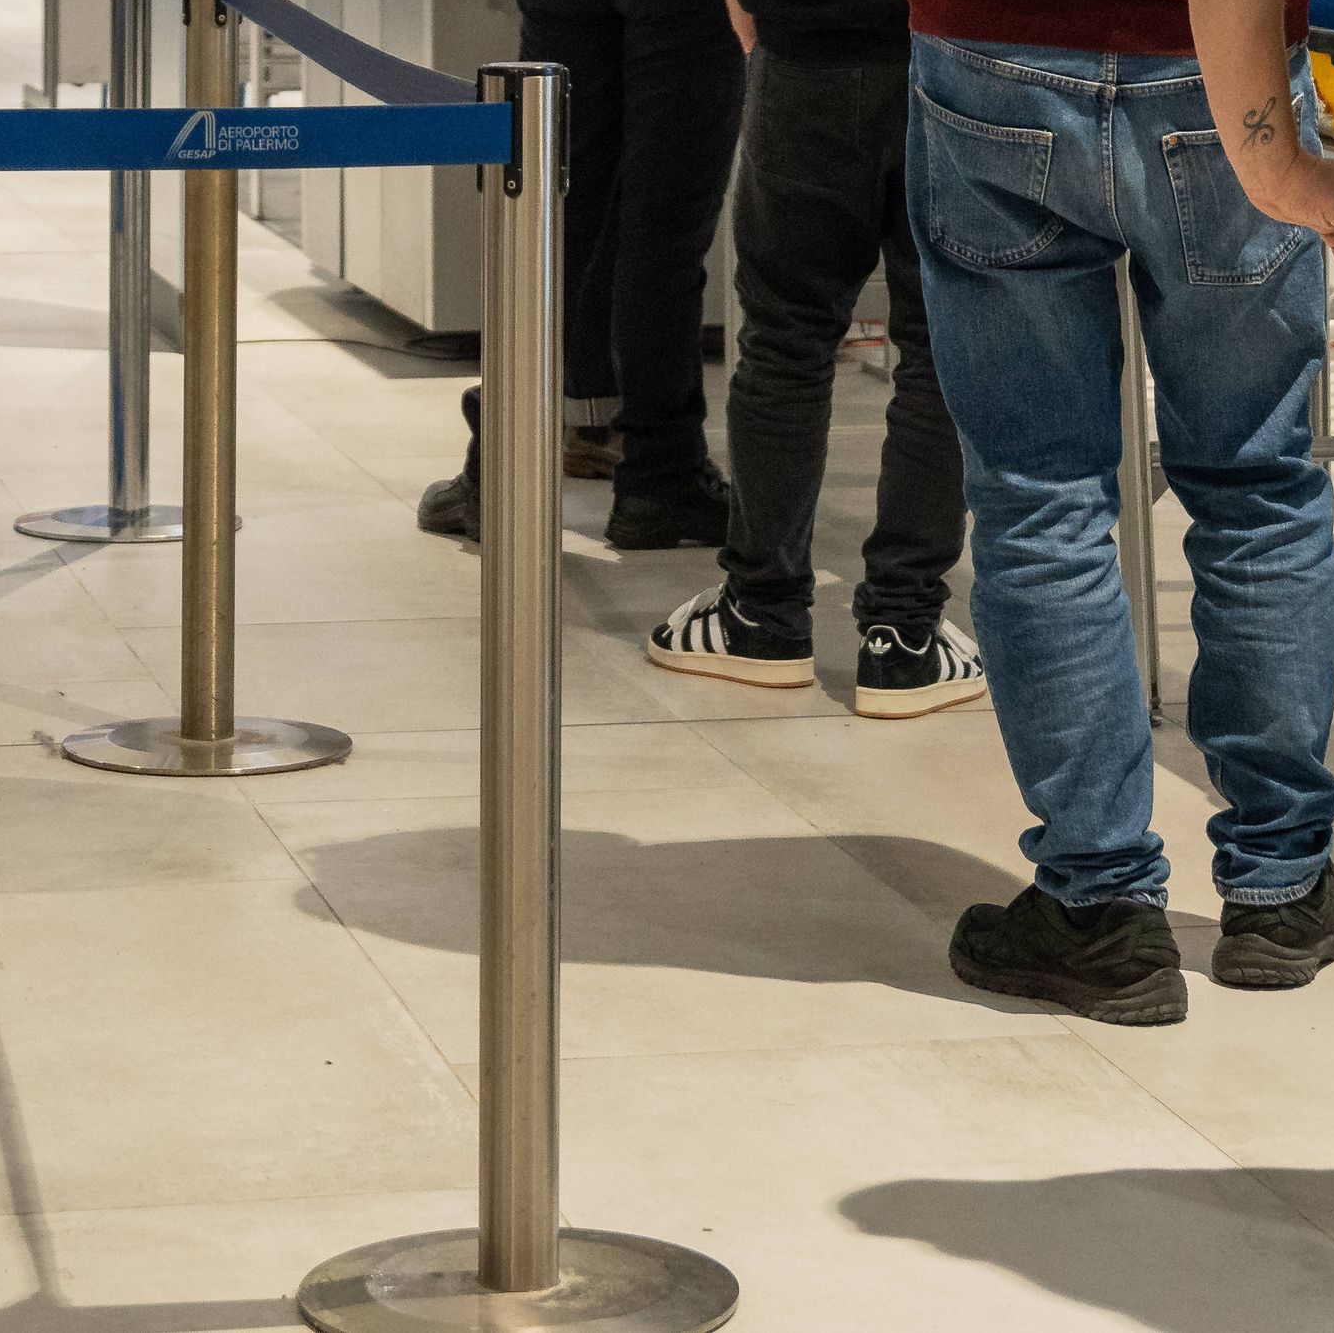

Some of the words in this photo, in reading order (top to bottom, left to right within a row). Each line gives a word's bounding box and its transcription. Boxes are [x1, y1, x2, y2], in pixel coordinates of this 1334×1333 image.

[218, 125, 299, 139] AEROPORTO
[218, 139, 232, 150] DI
[236, 139, 299, 151] PALERMO
[178, 150, 216, 159] GESAP
